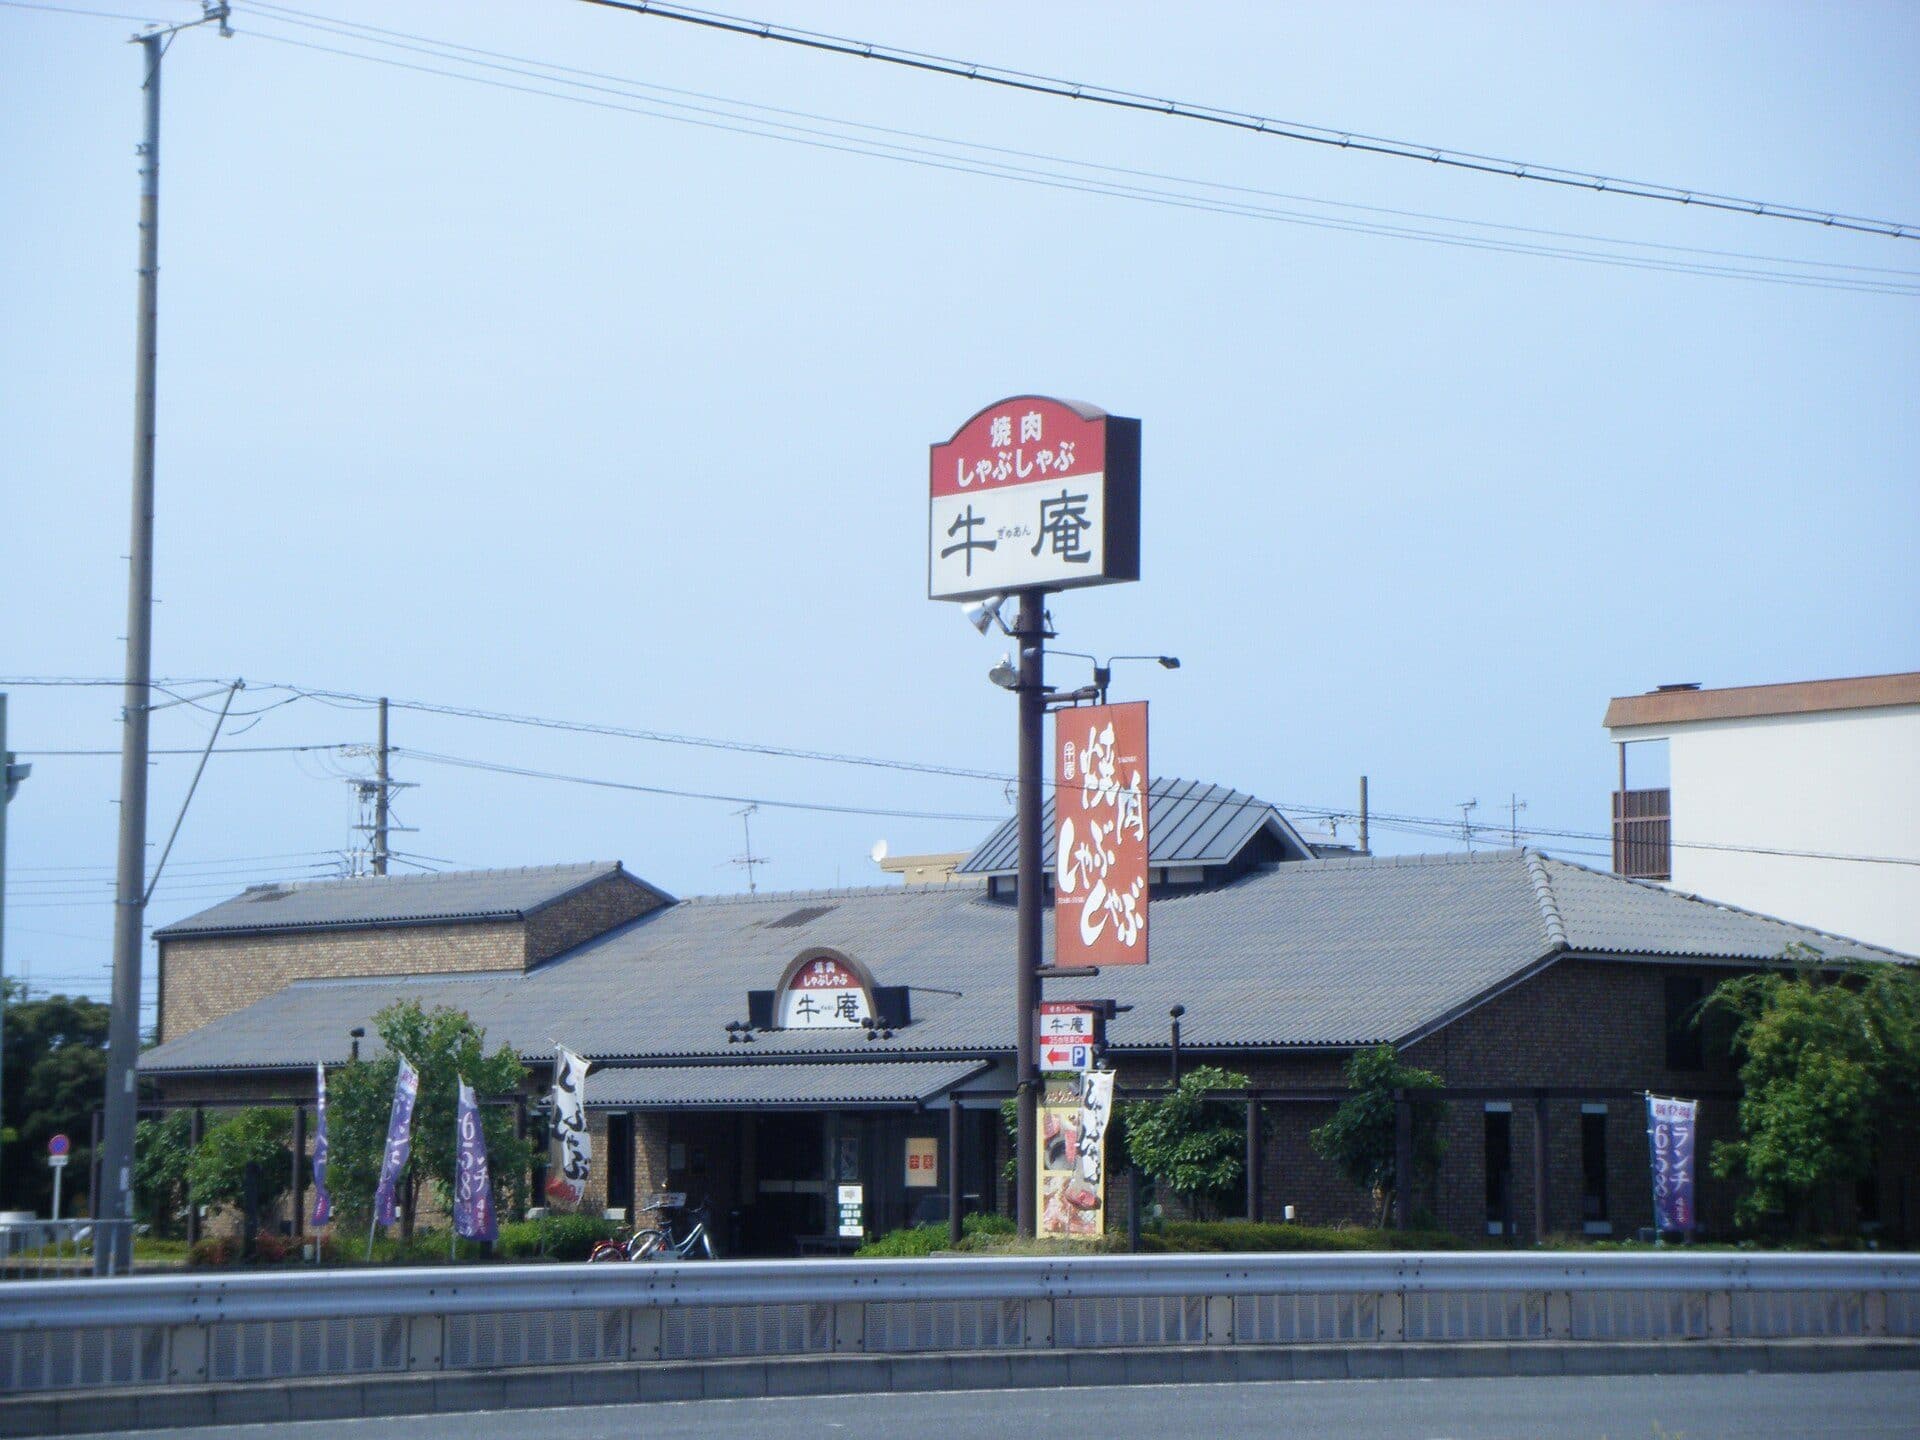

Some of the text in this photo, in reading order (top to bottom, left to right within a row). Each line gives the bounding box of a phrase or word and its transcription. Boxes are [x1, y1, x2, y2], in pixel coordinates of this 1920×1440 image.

[990, 411, 1042, 447] 焼肉
[957, 441, 1075, 487] しゃぶしゃぶ
[803, 973, 848, 987] しゃぶしゃぶ
[1074, 1048, 1083, 1064] P
[1669, 1126, 1690, 1191] ランチ
